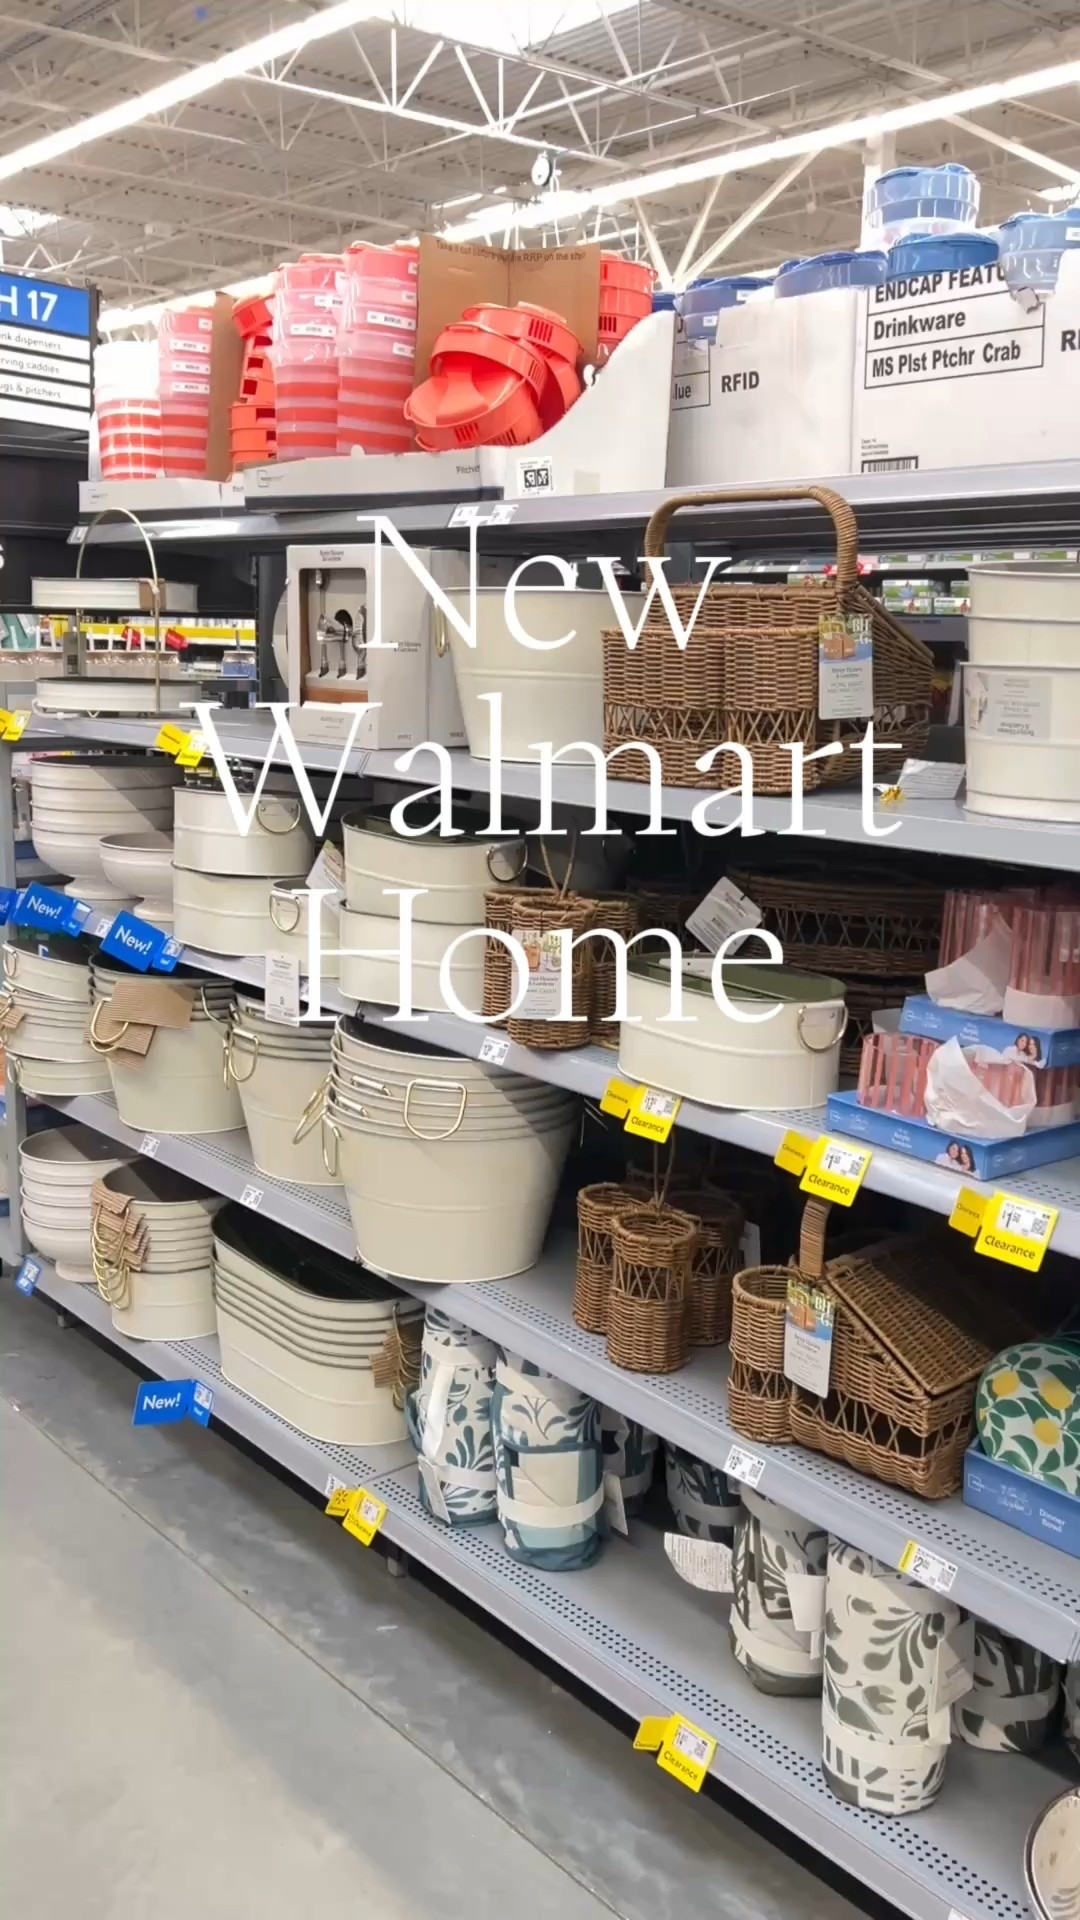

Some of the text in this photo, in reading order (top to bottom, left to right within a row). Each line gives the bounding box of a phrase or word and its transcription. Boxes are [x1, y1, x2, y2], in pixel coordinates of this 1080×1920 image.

[875, 275, 943, 303] ENDCAP
[27, 290, 59, 322] 17
[874, 311, 966, 340] Drinkware
[15, 334, 61, 350] dispensers
[1061, 330, 1080, 352] R
[26, 362, 59, 374] caddies
[872, 340, 1021, 378] MS Plst Ptchr Crab
[16, 384, 23, 392] &
[26, 387, 61, 399] pitchers
[721, 371, 760, 393] RFID
[27, 895, 63, 919] New!
[115, 925, 153, 955] New!
[631, 1116, 665, 1133] Clearance
[808, 1174, 850, 1195] Clearance
[984, 1235, 1036, 1259] Clearance
[142, 1392, 181, 1410] New!
[1039, 1508, 1066, 1526] Dinner
[664, 1751, 698, 1780] Clearance
